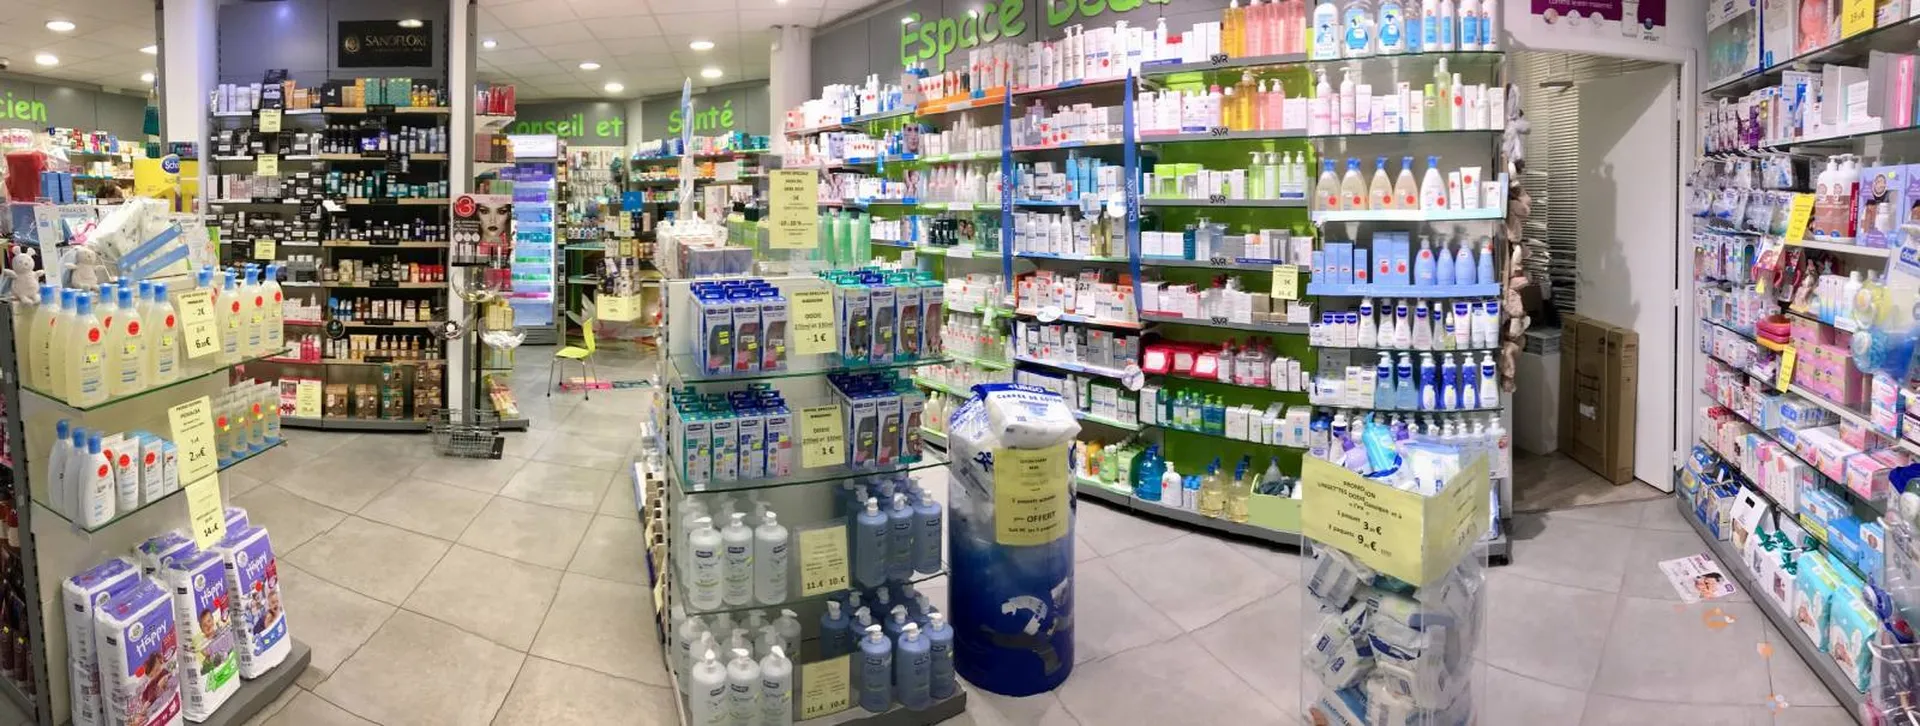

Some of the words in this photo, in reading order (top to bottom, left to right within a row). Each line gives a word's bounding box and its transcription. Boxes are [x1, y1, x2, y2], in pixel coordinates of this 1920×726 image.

[901, 0, 1026, 72] Espace
[1211, 54, 1228, 65] SVR
[514, 113, 584, 137] onseil
[595, 115, 624, 137] et
[667, 101, 734, 133] Snté
[1211, 128, 1228, 137] SVR
[1127, 179, 1135, 222] DUCRAY
[1209, 195, 1226, 205] SVR
[1210, 257, 1227, 266] SVR
[1211, 317, 1228, 326] SVR
[136, 620, 168, 658] Happy
